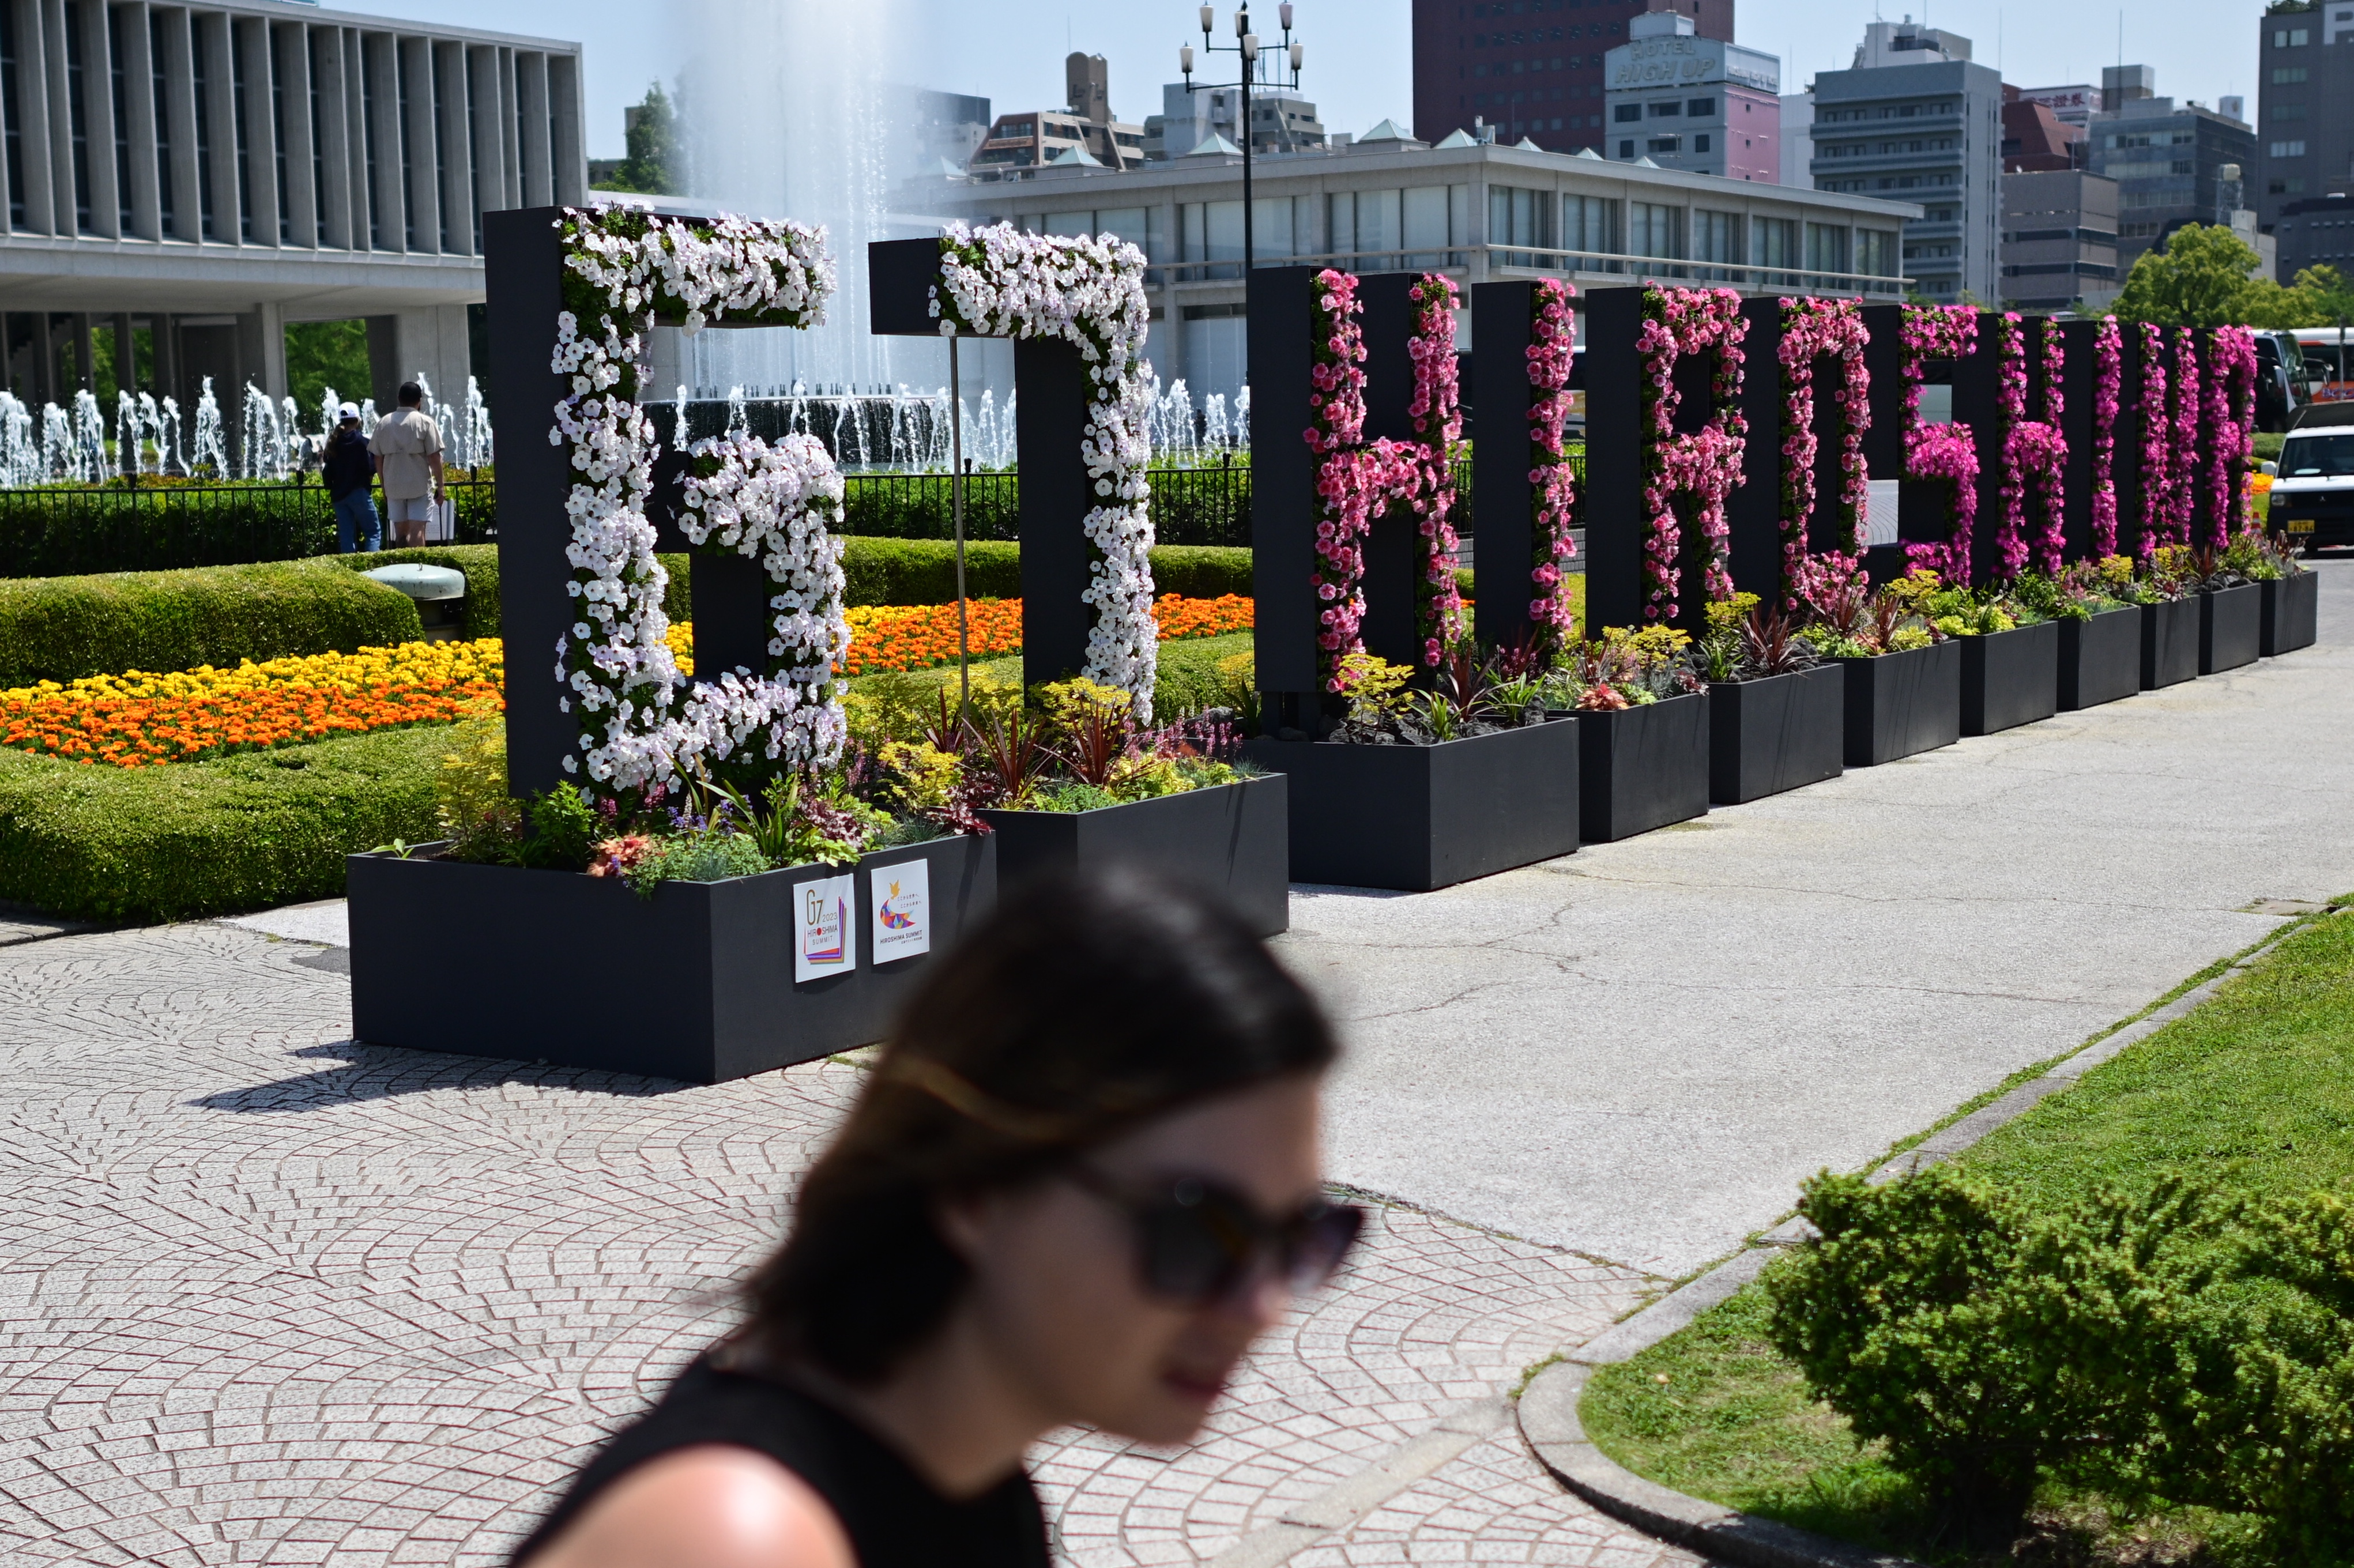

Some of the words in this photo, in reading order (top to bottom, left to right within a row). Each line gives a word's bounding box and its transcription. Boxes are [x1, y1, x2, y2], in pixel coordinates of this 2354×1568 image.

[1631, 38, 1695, 61] HOTEL
[1615, 61, 1678, 84] HIGH
[1683, 58, 1715, 78] UP
[1303, 266, 2258, 695] HIROSHIMA
[807, 889, 823, 925] G7
[822, 912, 838, 922] 2023
[807, 924, 838, 938] HIROSHIMA
[880, 934, 905, 944] HIROSHIMA
[905, 930, 922, 939] SUMMIT
[812, 936, 833, 945] SUMMIT
